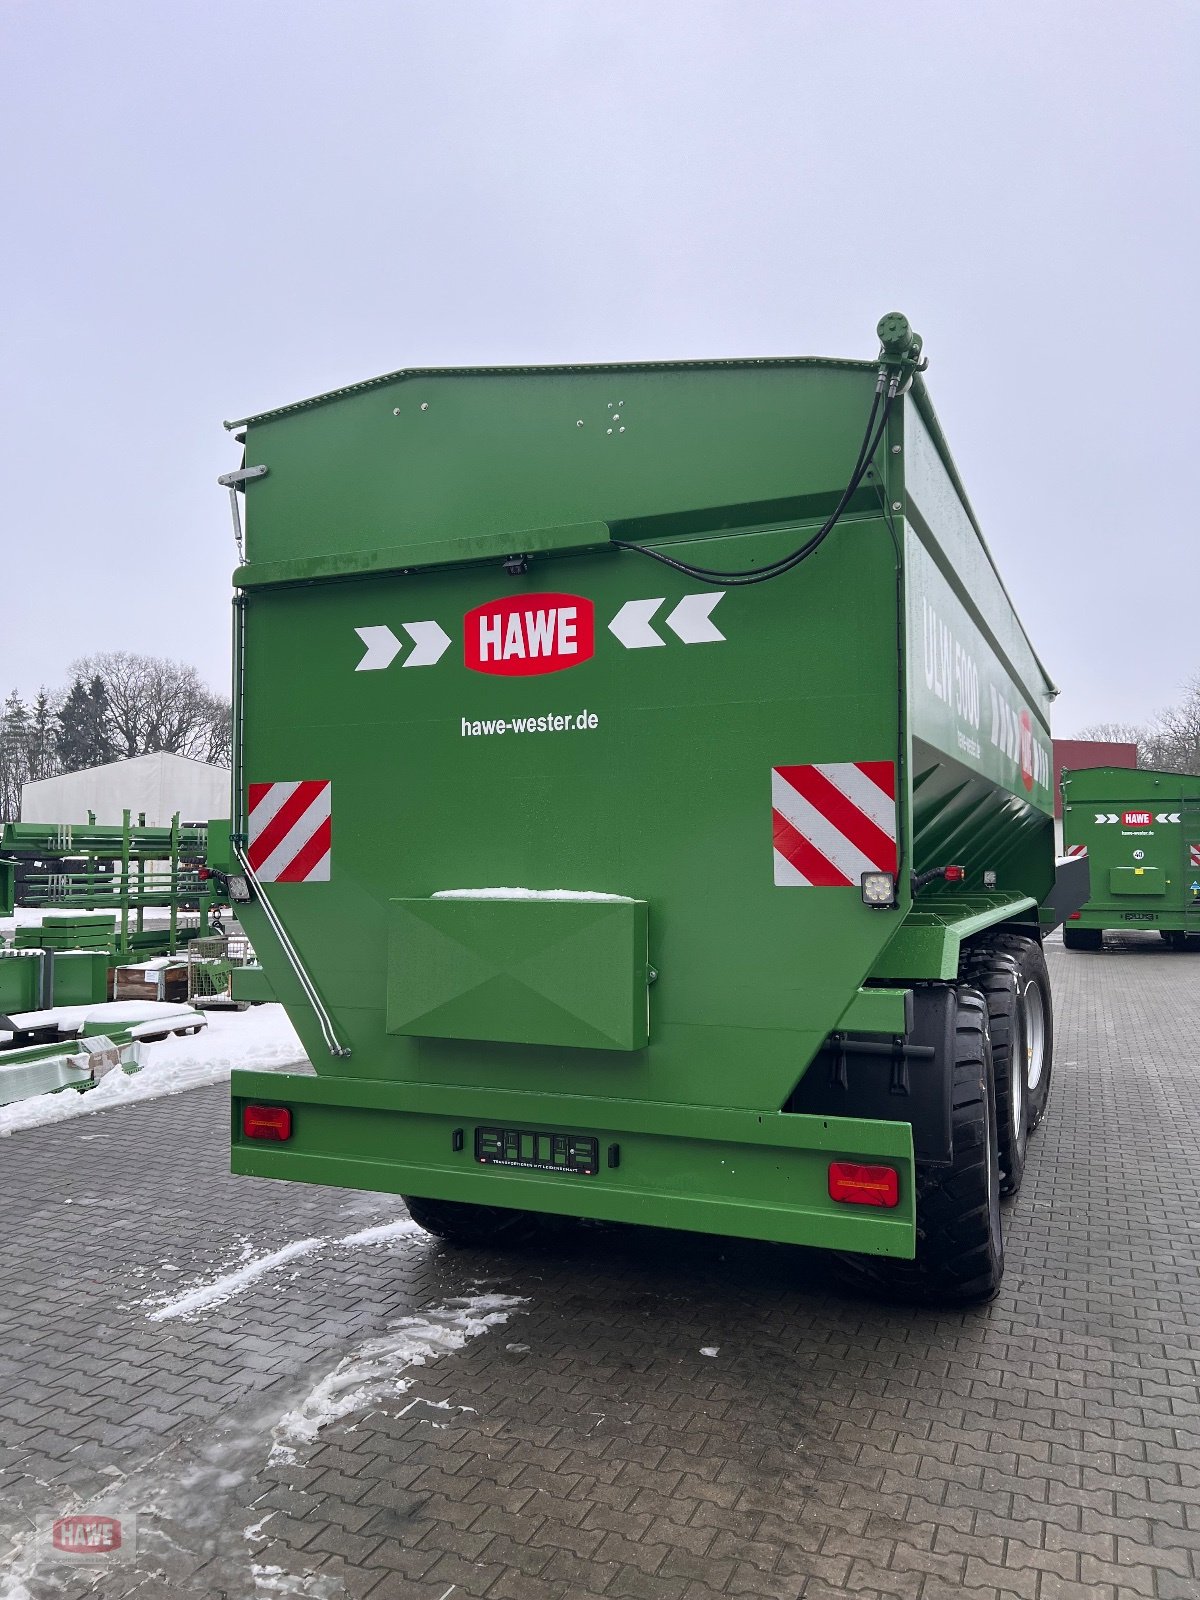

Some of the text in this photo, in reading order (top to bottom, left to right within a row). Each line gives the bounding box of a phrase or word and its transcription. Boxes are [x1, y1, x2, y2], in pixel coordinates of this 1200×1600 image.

[479, 606, 577, 661] HAWE
[955, 639, 980, 730] 5000
[461, 709, 599, 737] hawe-wester.de
[1125, 813, 1150, 824] HAWE
